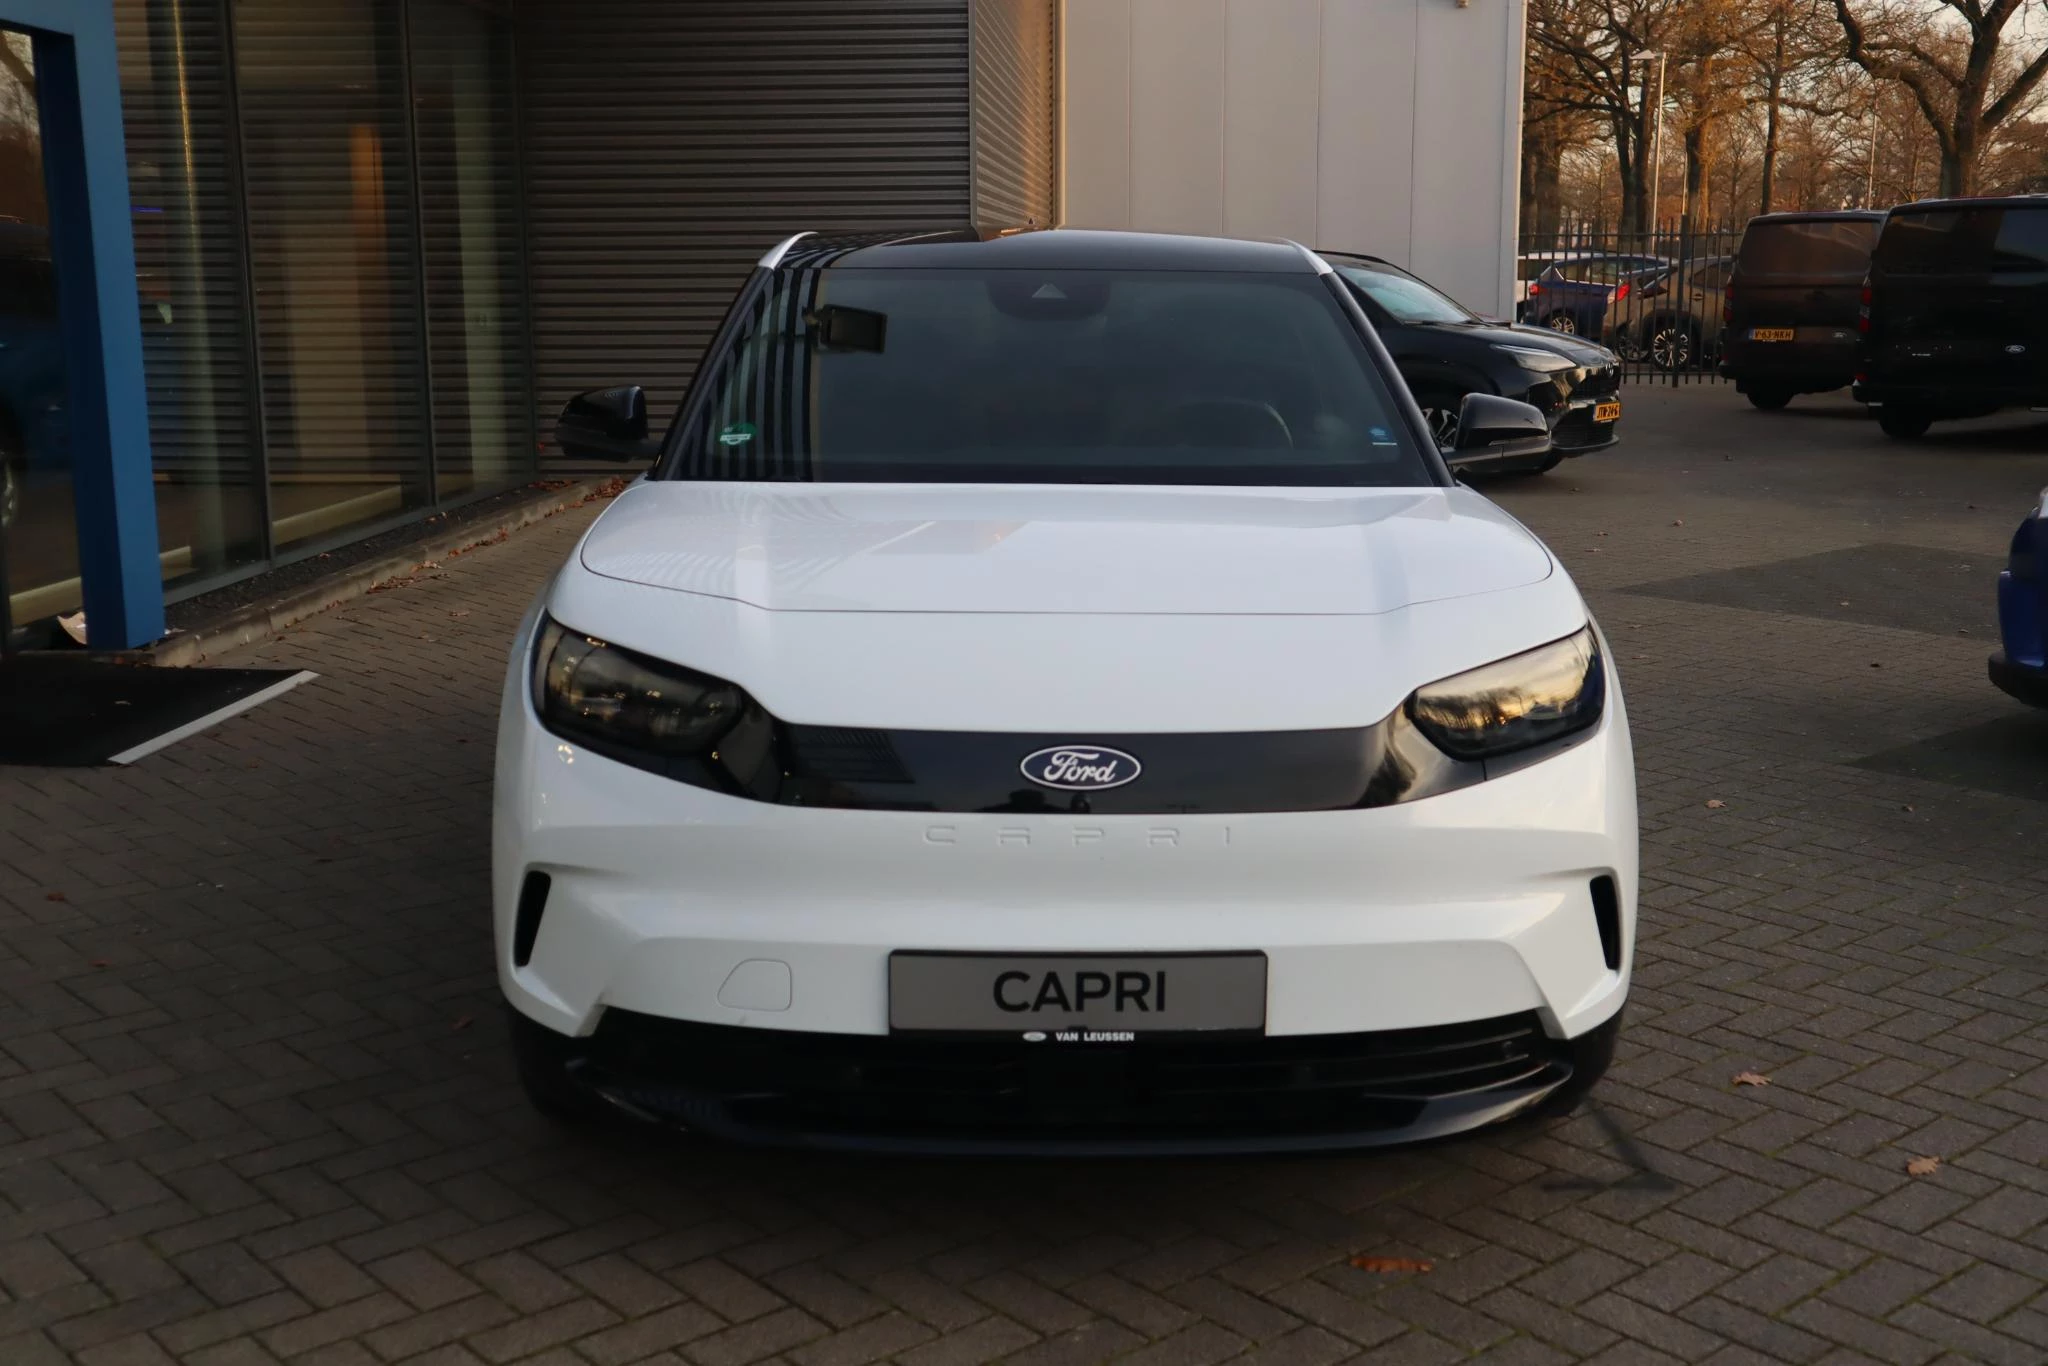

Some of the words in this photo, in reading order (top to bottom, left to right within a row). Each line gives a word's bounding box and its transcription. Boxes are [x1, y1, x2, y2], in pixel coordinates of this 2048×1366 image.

[1044, 751, 1117, 782] Ford
[924, 825, 1231, 845] CAPRI
[993, 970, 1165, 1012] CAPRI
[1055, 1031, 1079, 1041] VAN
[1083, 1031, 1135, 1041] LEUSSEN
